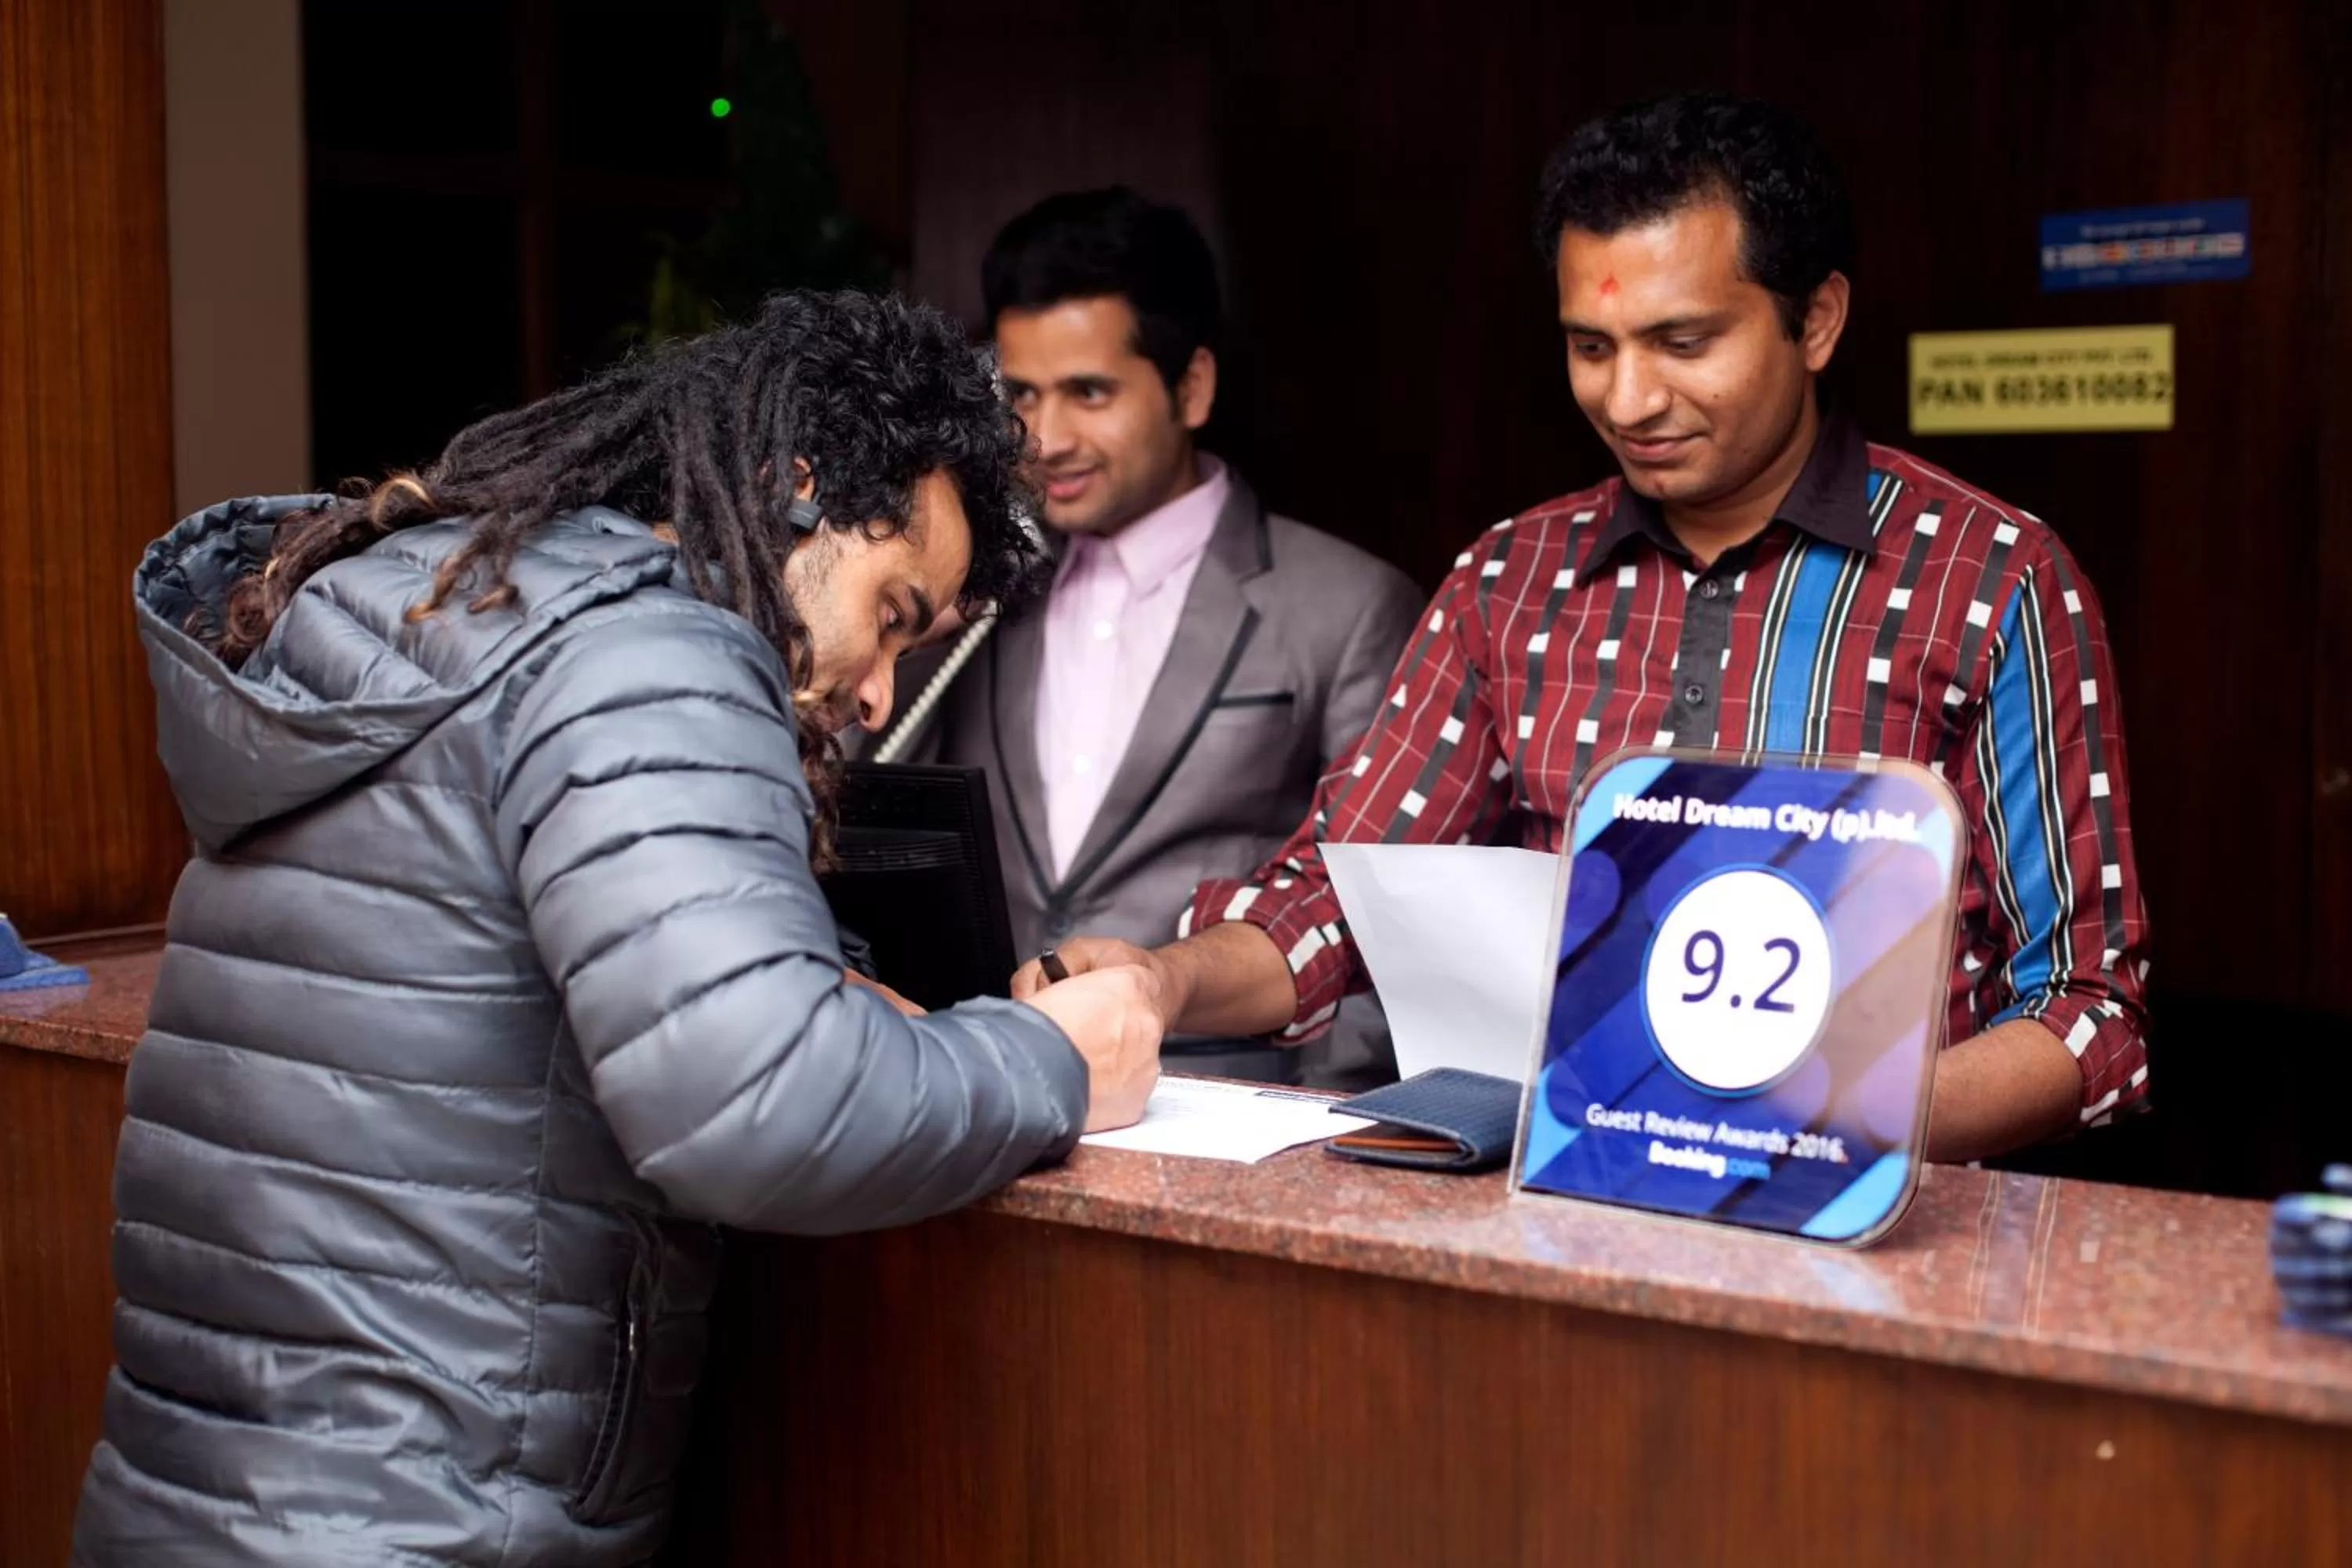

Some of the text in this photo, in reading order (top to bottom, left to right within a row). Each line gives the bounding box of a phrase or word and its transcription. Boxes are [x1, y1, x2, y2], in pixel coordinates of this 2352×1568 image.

[1918, 376, 1984, 408] PAN
[1613, 793, 1682, 823] Hotel
[1685, 798, 1771, 830] Dream
[1775, 804, 1829, 840] City
[1682, 929, 1801, 1014] 9.2
[1585, 1102, 1642, 1132] Guest
[1644, 1110, 1713, 1142] Review
[1712, 1120, 1789, 1155] Awards
